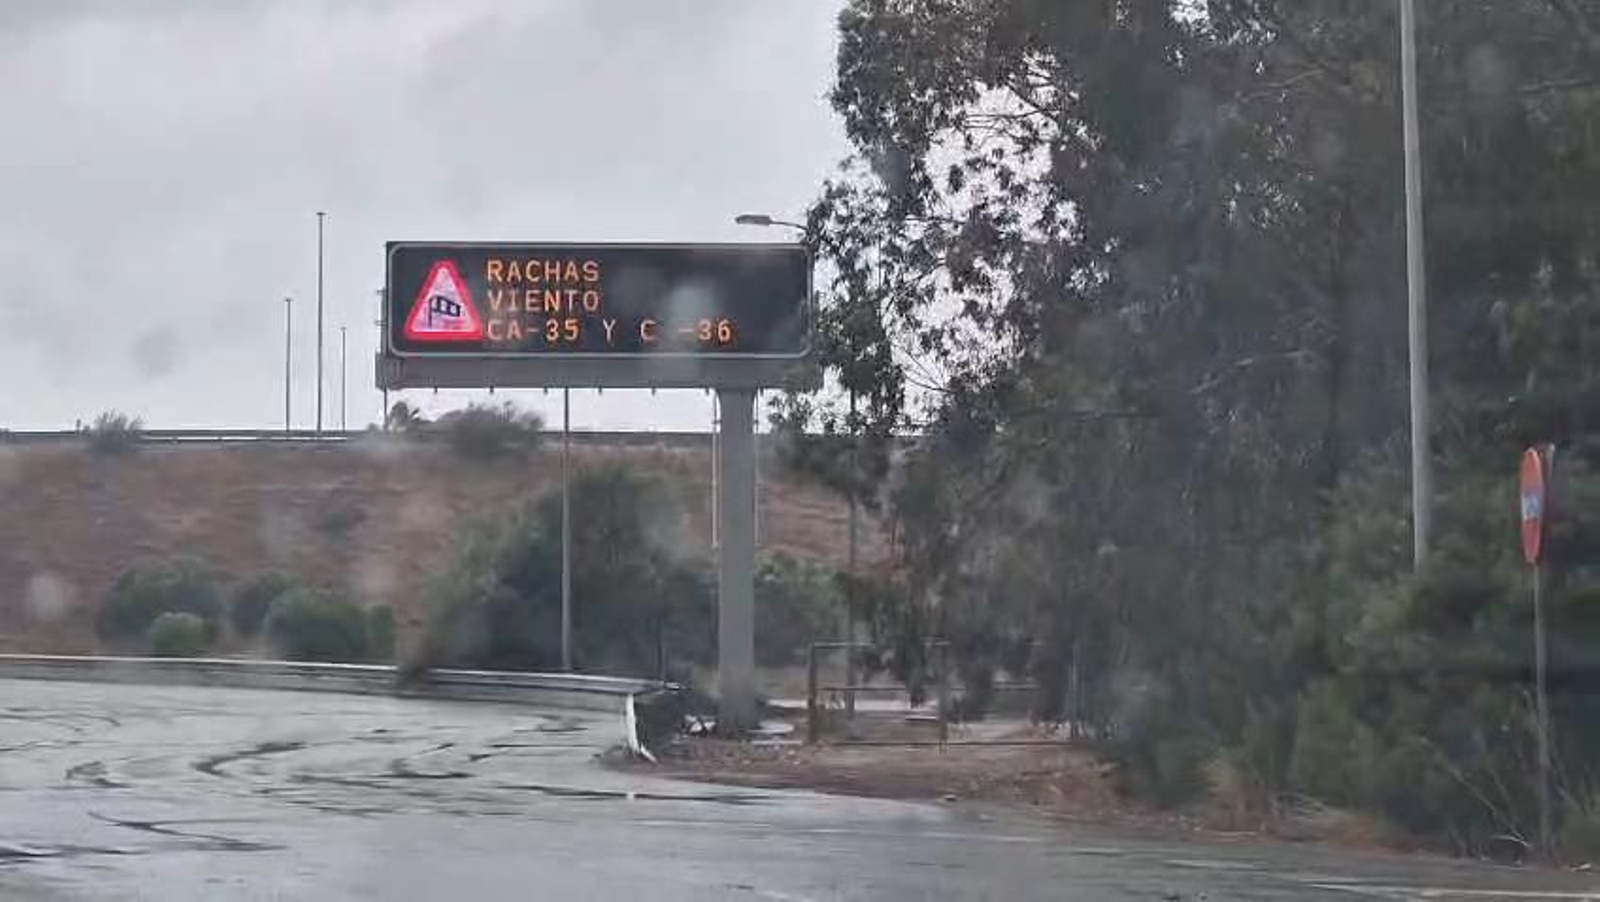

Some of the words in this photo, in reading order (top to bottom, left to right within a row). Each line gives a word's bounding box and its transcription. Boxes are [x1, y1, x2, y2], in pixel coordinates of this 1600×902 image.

[487, 259, 599, 282] RACHAS
[487, 289, 600, 312] VIENTO
[487, 318, 579, 341] CA-35
[602, 318, 617, 341] Y
[640, 319, 731, 341] C-36
